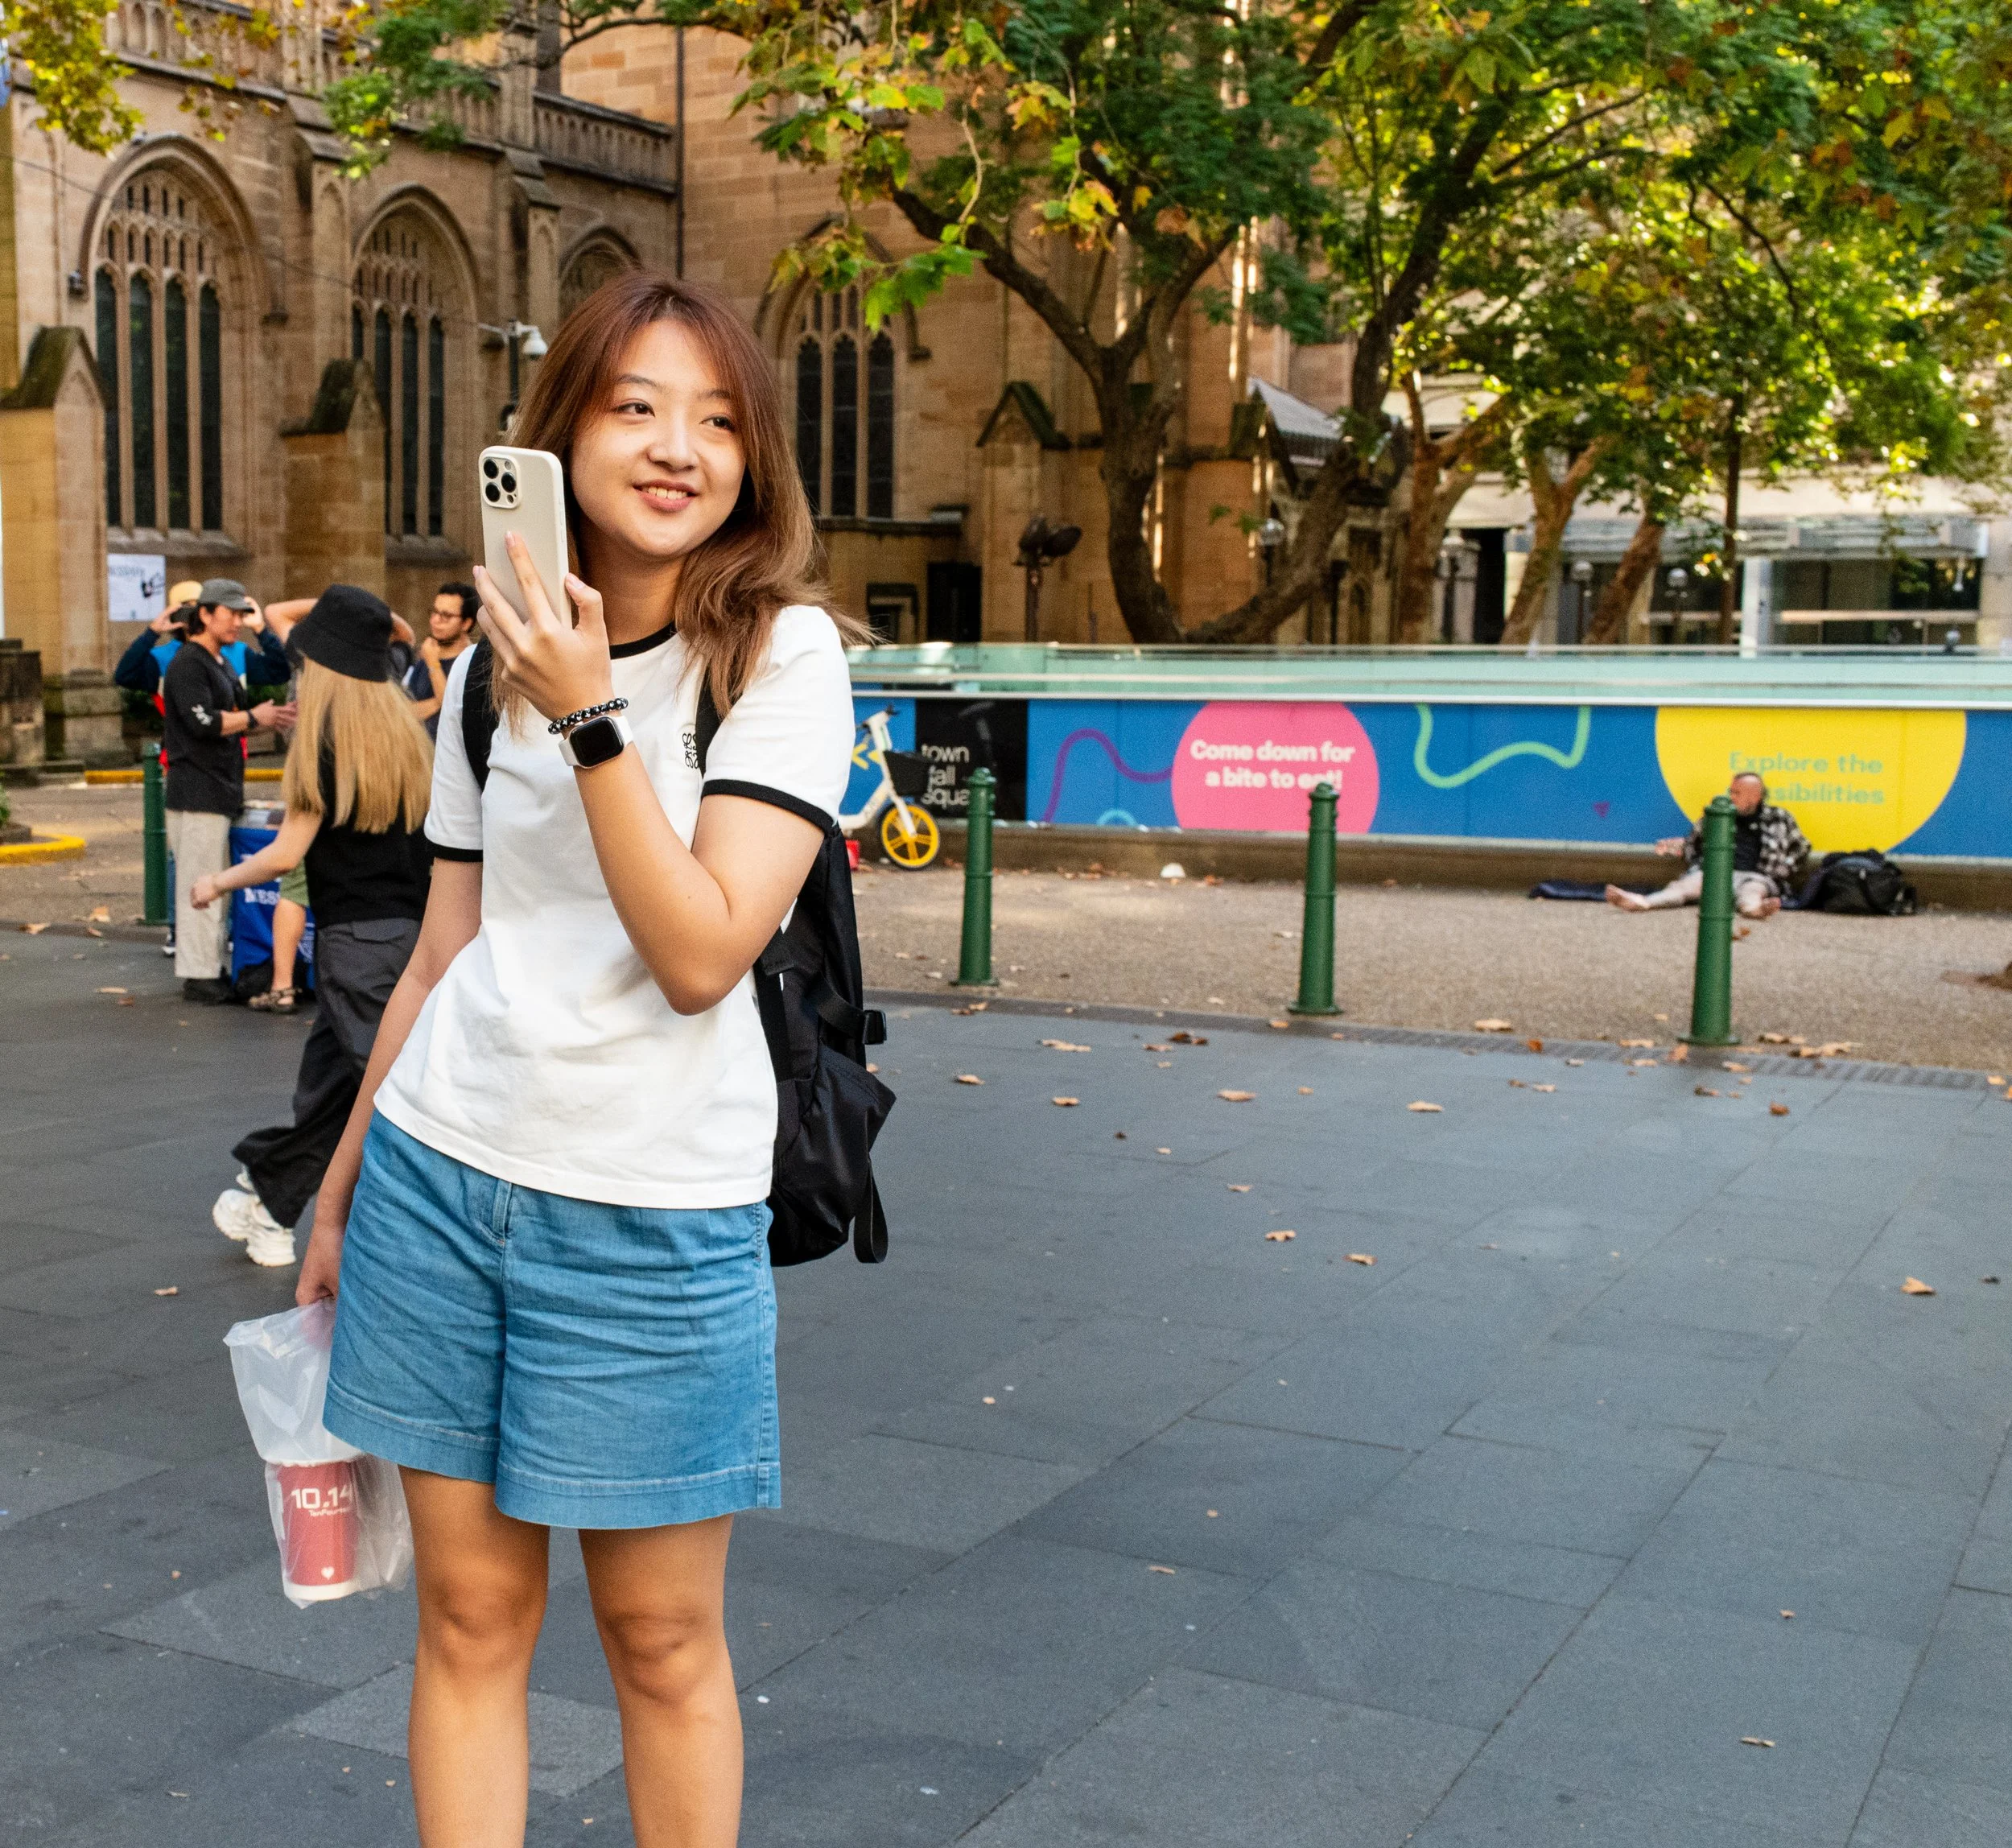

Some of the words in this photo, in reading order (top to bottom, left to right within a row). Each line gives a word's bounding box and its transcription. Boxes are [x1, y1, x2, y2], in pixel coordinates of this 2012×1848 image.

[921, 744, 970, 762] town
[1190, 739, 1254, 761] Come
[1256, 740, 1318, 761] down
[1320, 740, 1356, 762] for
[1729, 751, 1829, 777] Explore
[1837, 753, 1883, 774] the
[1205, 770, 1221, 787] a
[1222, 766, 1268, 788] bite
[1269, 768, 1296, 789] to
[921, 788, 971, 811] squa
[291, 1485, 354, 1509] 10.14
